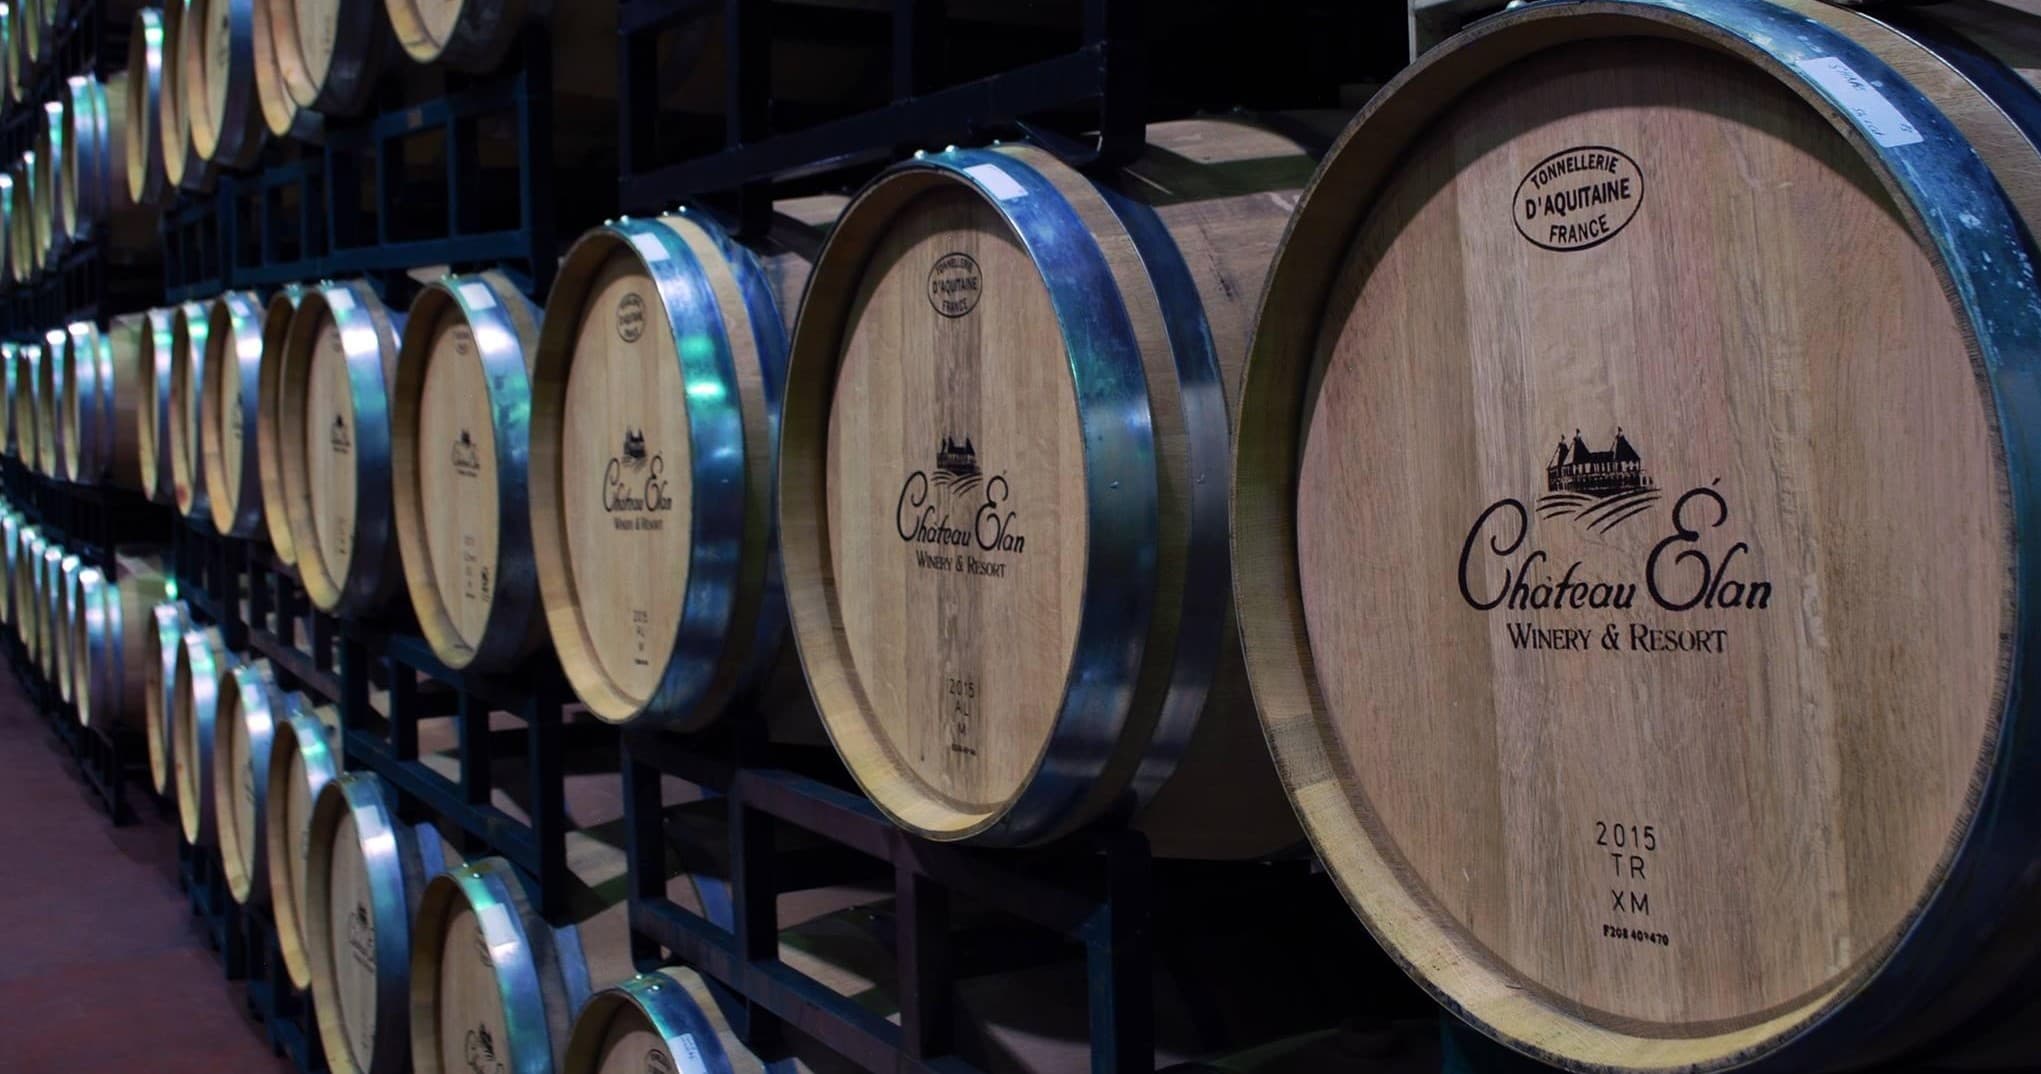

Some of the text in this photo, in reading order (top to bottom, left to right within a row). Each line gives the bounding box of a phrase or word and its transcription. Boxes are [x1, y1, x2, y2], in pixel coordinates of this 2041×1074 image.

[1530, 154, 1619, 190] TONNELLERIE
[1525, 178, 1631, 220] D'AQUITAINE
[1549, 214, 1610, 243] FRANCE
[1600, 623, 1619, 651] &
[1596, 821, 1656, 851] 2015
[1611, 853, 1645, 879] TR
[1611, 889, 1649, 915] XM
